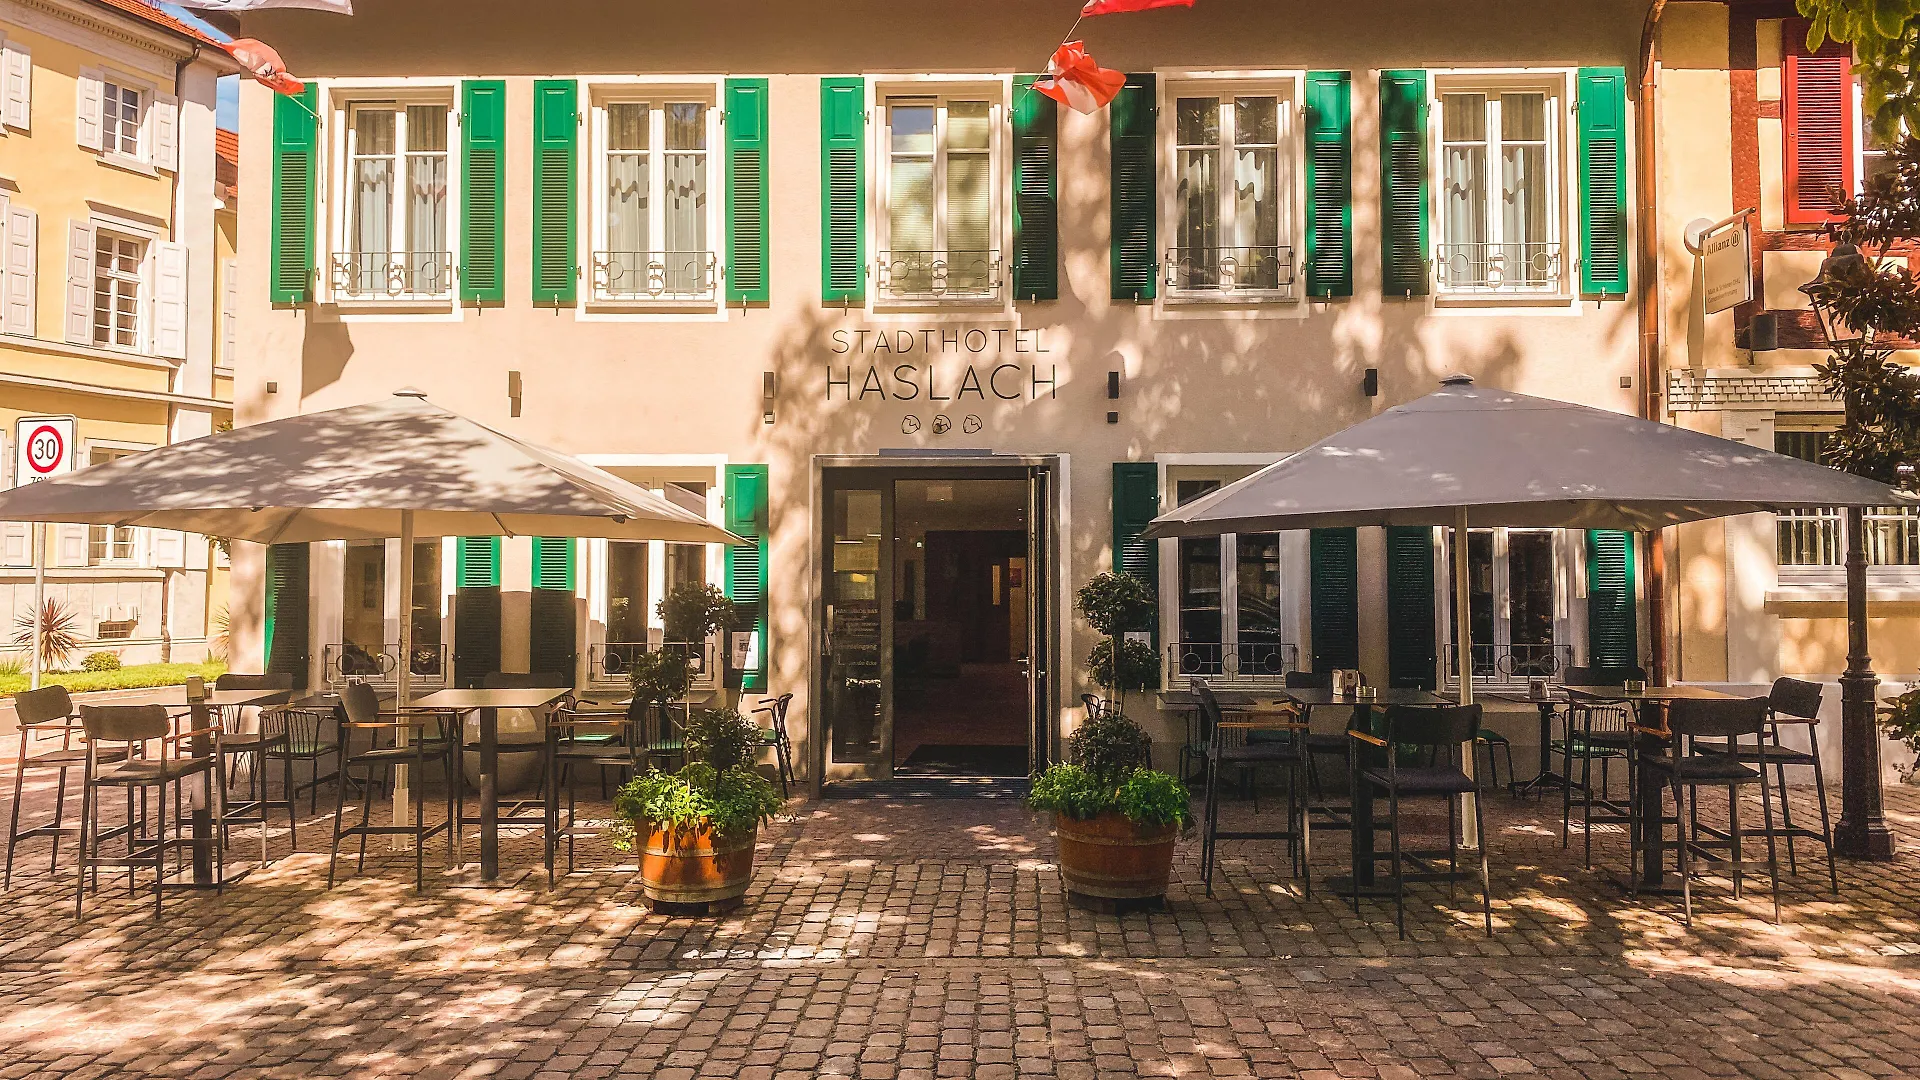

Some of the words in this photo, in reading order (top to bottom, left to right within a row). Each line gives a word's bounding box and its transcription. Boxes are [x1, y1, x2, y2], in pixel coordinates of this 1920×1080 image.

[1706, 238, 1730, 256] Allianz
[831, 329, 1050, 353] STADTHOTEL
[827, 364, 1056, 401] HASLACH
[34, 438, 56, 460] 30
